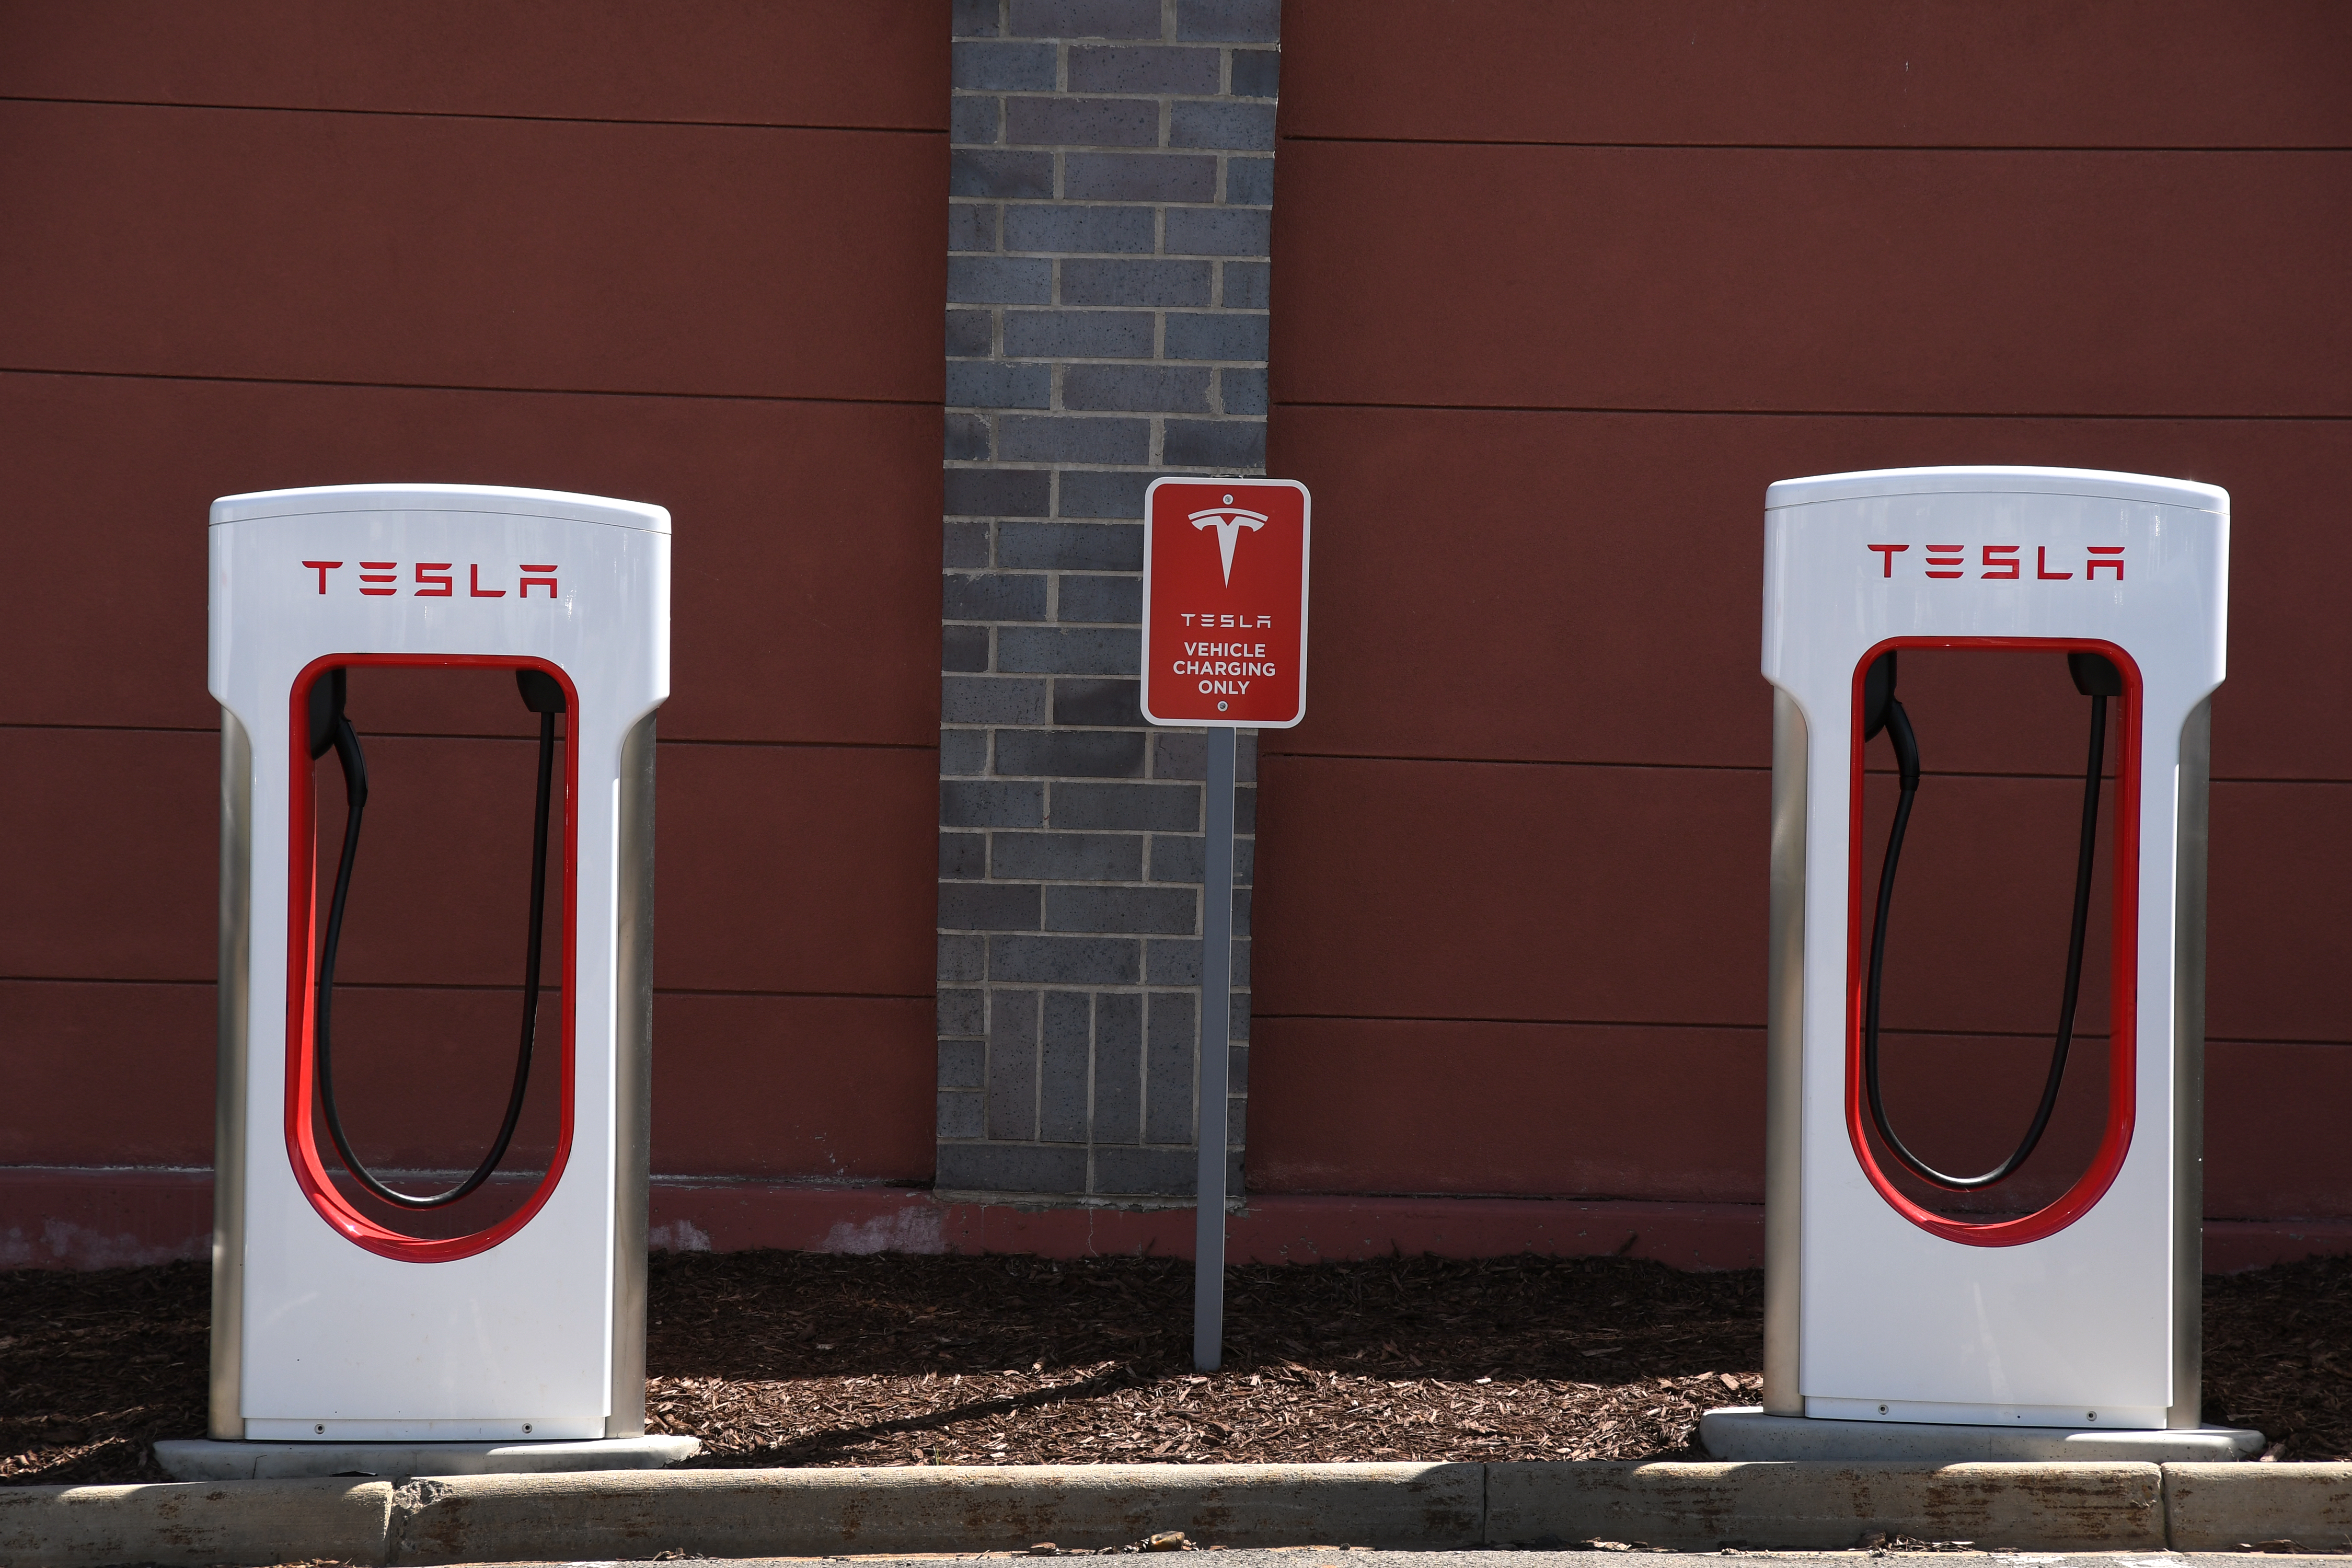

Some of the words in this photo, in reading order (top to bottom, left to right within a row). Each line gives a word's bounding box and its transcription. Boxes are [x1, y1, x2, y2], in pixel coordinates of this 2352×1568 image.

[1867, 545, 2125, 580] TESLA
[302, 561, 558, 598] TESLA
[1181, 614, 1271, 628] TESLA
[1184, 642, 1265, 658] VEHICLE
[1173, 660, 1275, 676] CHARGING
[1198, 680, 1250, 695] ONLY
